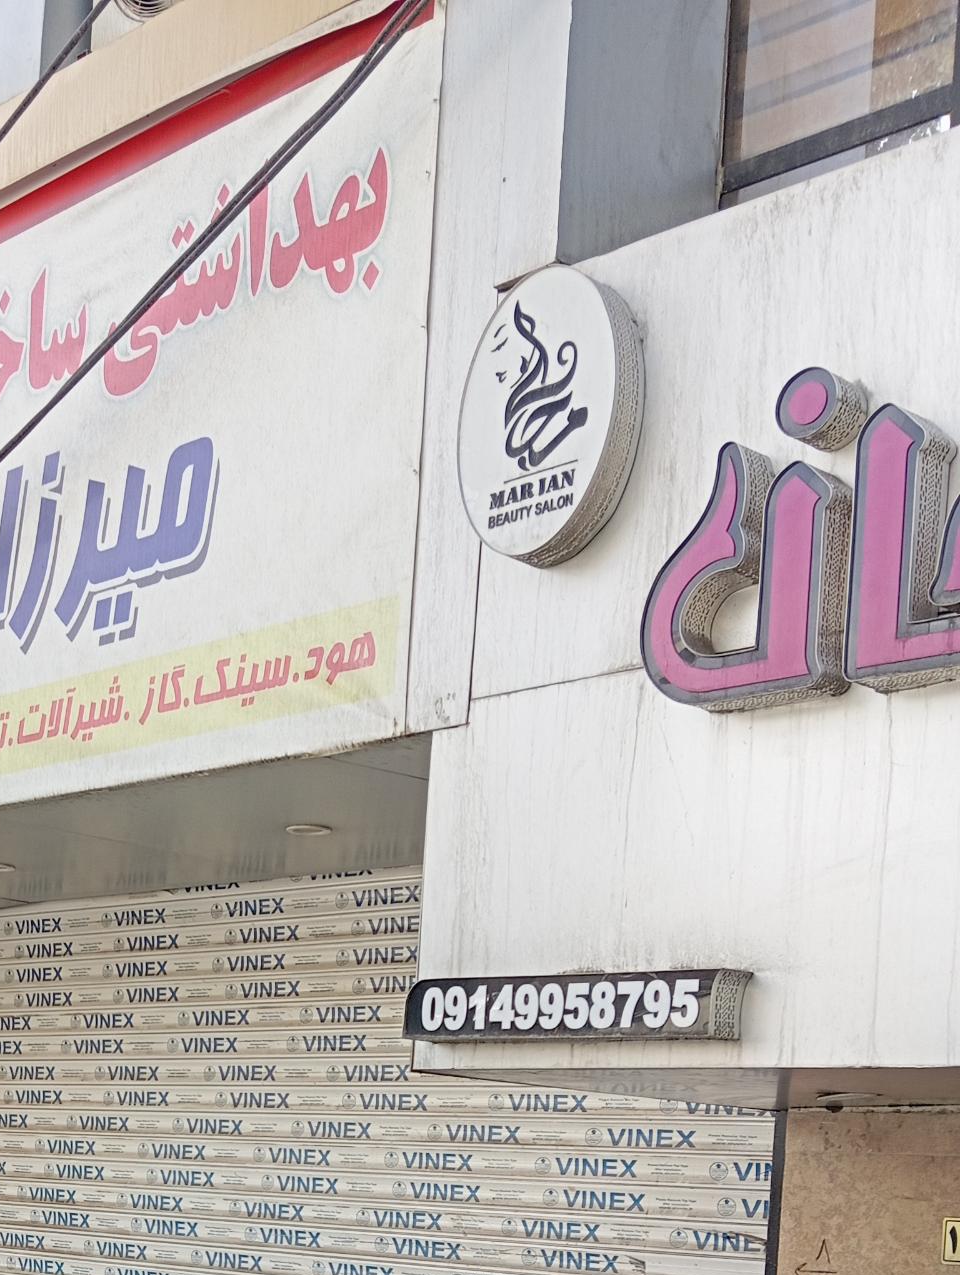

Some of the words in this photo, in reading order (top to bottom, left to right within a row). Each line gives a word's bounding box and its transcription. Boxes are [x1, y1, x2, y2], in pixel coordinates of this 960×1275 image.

[102, 147, 390, 397] بهداشتی
[488, 505, 532, 529] BEAUTY
[535, 493, 573, 516] SALON
[15, 917, 61, 934] VINEX
[225, 897, 284, 917] VINEX
[352, 885, 419, 906] VINEX
[25, 942, 72, 958] VINEX
[126, 934, 179, 952] VINEX
[239, 924, 299, 944] VINEX
[16, 966, 62, 982] VINEX
[226, 953, 285, 972] VINEX
[352, 945, 420, 965] VINEX
[25, 991, 72, 1007] VINEX
[126, 986, 179, 1003] VINEX
[240, 980, 300, 998] VINEX
[421, 979, 700, 1031] 09149958795
[83, 1013, 133, 1028] VINEX
[192, 1009, 249, 1026] VINEX
[315, 1005, 381, 1023] VINEX
[73, 1039, 123, 1053] VINEX
[181, 1037, 237, 1052] VINEX
[302, 1035, 366, 1051] VINEX
[9, 1066, 55, 1080] VINEX
[218, 1065, 276, 1081] VINEX
[342, 1065, 409, 1081] VINEX
[116, 1091, 168, 1106] VINEX
[230, 1092, 289, 1108] VINEX
[508, 1094, 586, 1113] VINEX
[186, 1118, 242, 1135] VINEX
[307, 1121, 371, 1139] VINEX
[607, 1128, 693, 1149] VINEX
[151, 1143, 205, 1160] VINEX
[268, 1147, 330, 1166] VINEX
[554, 1156, 637, 1178] VINEX
[159, 1169, 214, 1187] VINEX
[276, 1175, 339, 1194] VINEX
[562, 1189, 645, 1212] VINEX
[129, 1193, 183, 1212] VINEX
[243, 1201, 304, 1221] VINEX
[520, 1219, 600, 1242] VINEX
[96, 1240, 147, 1260] VINEX
[144, 1218, 198, 1238] VINEX
[259, 1227, 320, 1248] VINEX
[539, 1249, 620, 1274] VINEX
